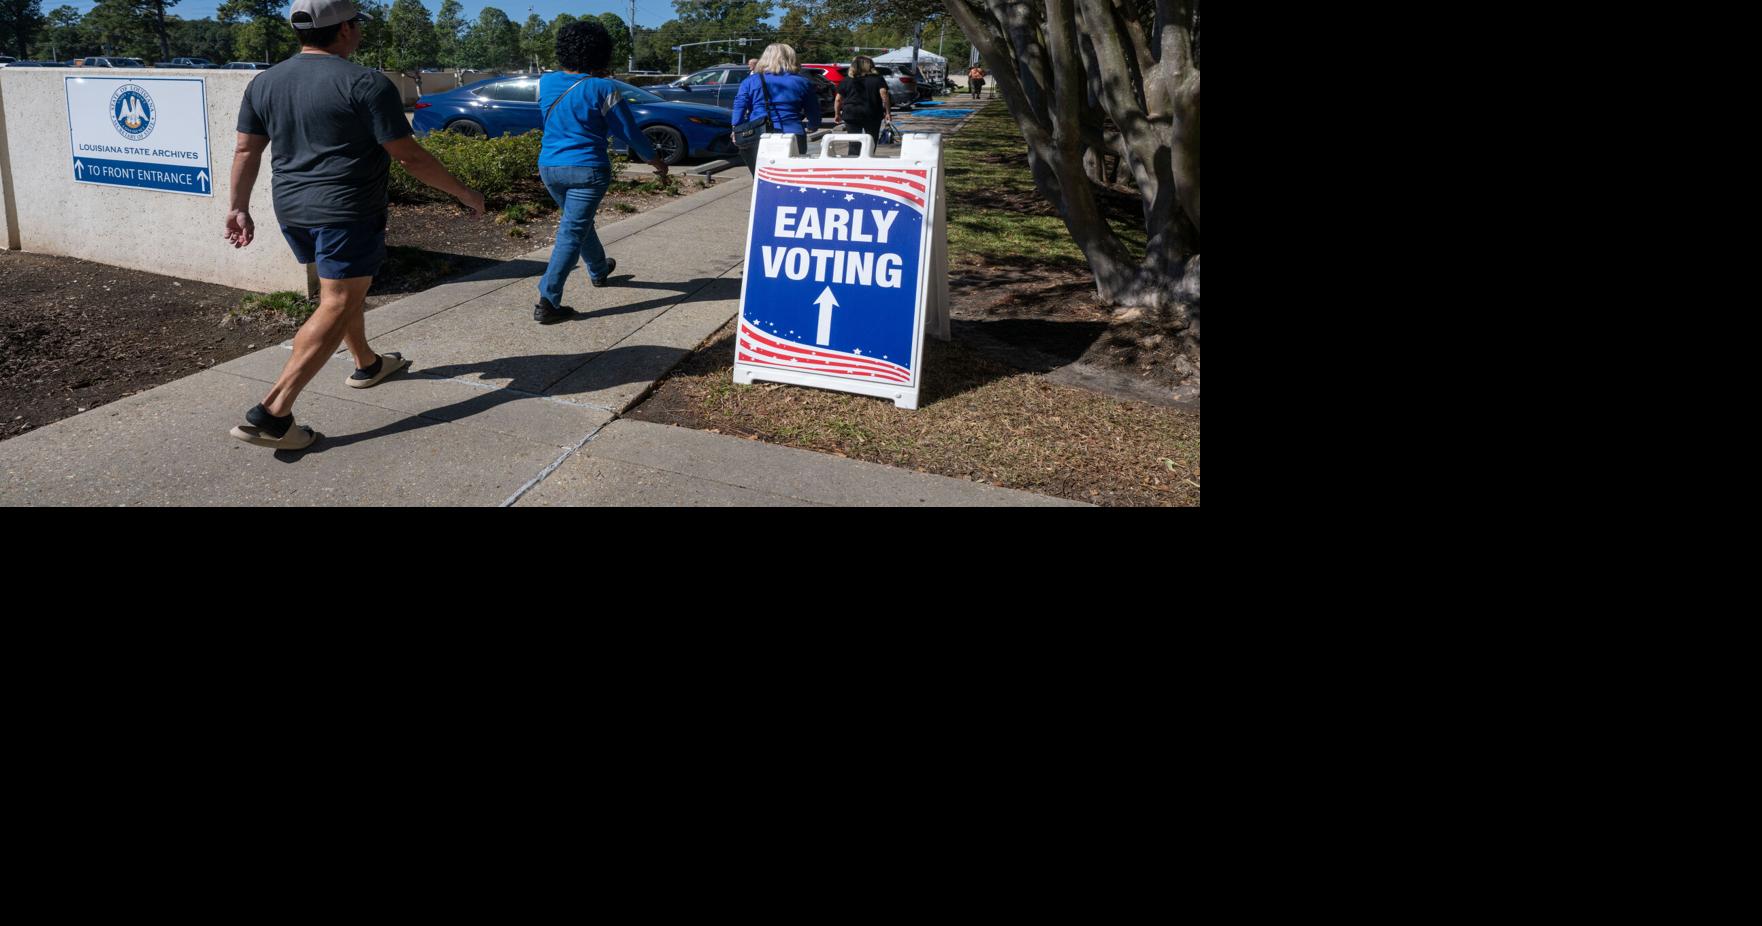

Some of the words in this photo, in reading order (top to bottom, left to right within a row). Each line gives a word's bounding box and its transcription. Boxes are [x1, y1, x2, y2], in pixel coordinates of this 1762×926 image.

[79, 143, 124, 154] LOUISIANA
[124, 147, 150, 156] STATE
[152, 149, 199, 160] ARCHIVES
[87, 164, 101, 176] TO
[102, 166, 135, 179] FRONT
[138, 169, 193, 185] ENTRANCE
[774, 205, 900, 243] EARLY
[761, 245, 903, 289] VOTING
